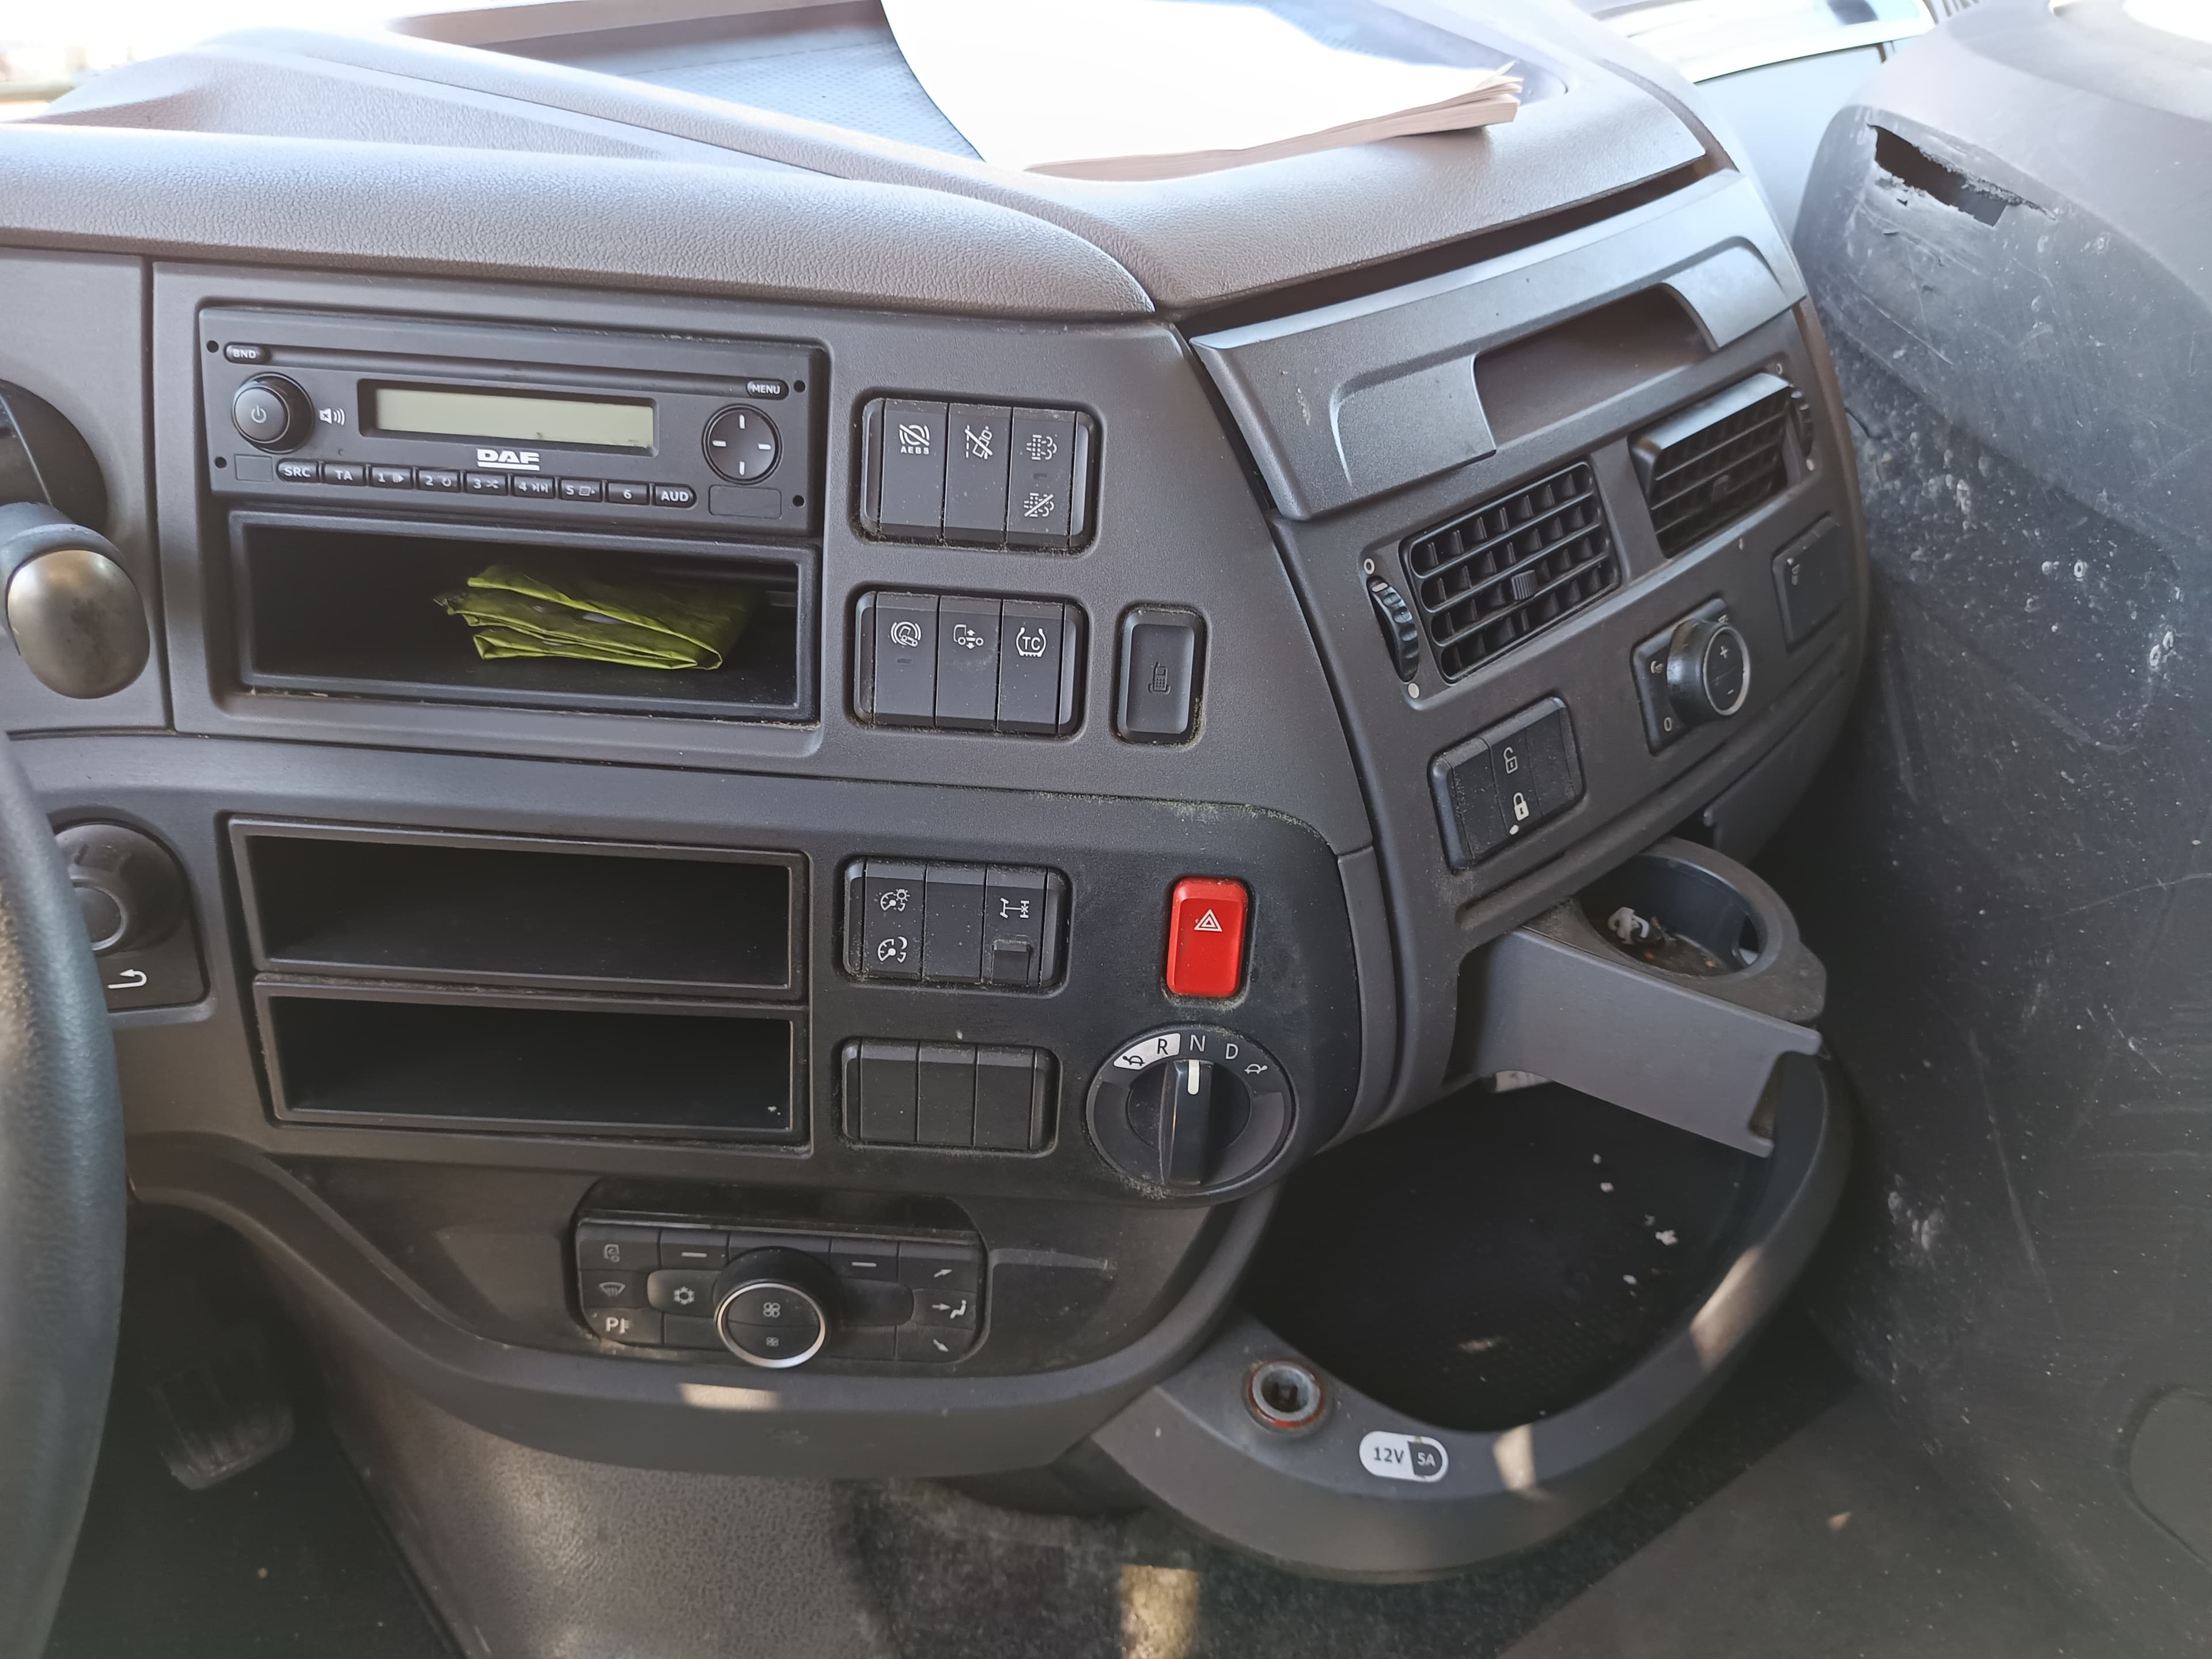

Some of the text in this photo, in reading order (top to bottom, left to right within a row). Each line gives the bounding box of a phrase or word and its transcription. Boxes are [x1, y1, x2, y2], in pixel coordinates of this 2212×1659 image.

[233, 349, 256, 359] BND
[752, 384, 781, 395] MENU
[477, 448, 540, 464] DAF
[900, 446, 929, 455] AEBS
[285, 467, 311, 478] SRC
[336, 470, 353, 481] TA
[378, 474, 385, 483] 1
[426, 476, 433, 486] 2
[473, 479, 482, 489] 3
[518, 482, 527, 491] 4
[566, 485, 574, 495] 5
[623, 489, 632, 500] 6
[661, 490, 689, 502] AUD
[1024, 637, 1041, 650] TC
[1157, 1035, 1238, 1059] R N D
[1373, 1446, 1436, 1467] 12V 5A
